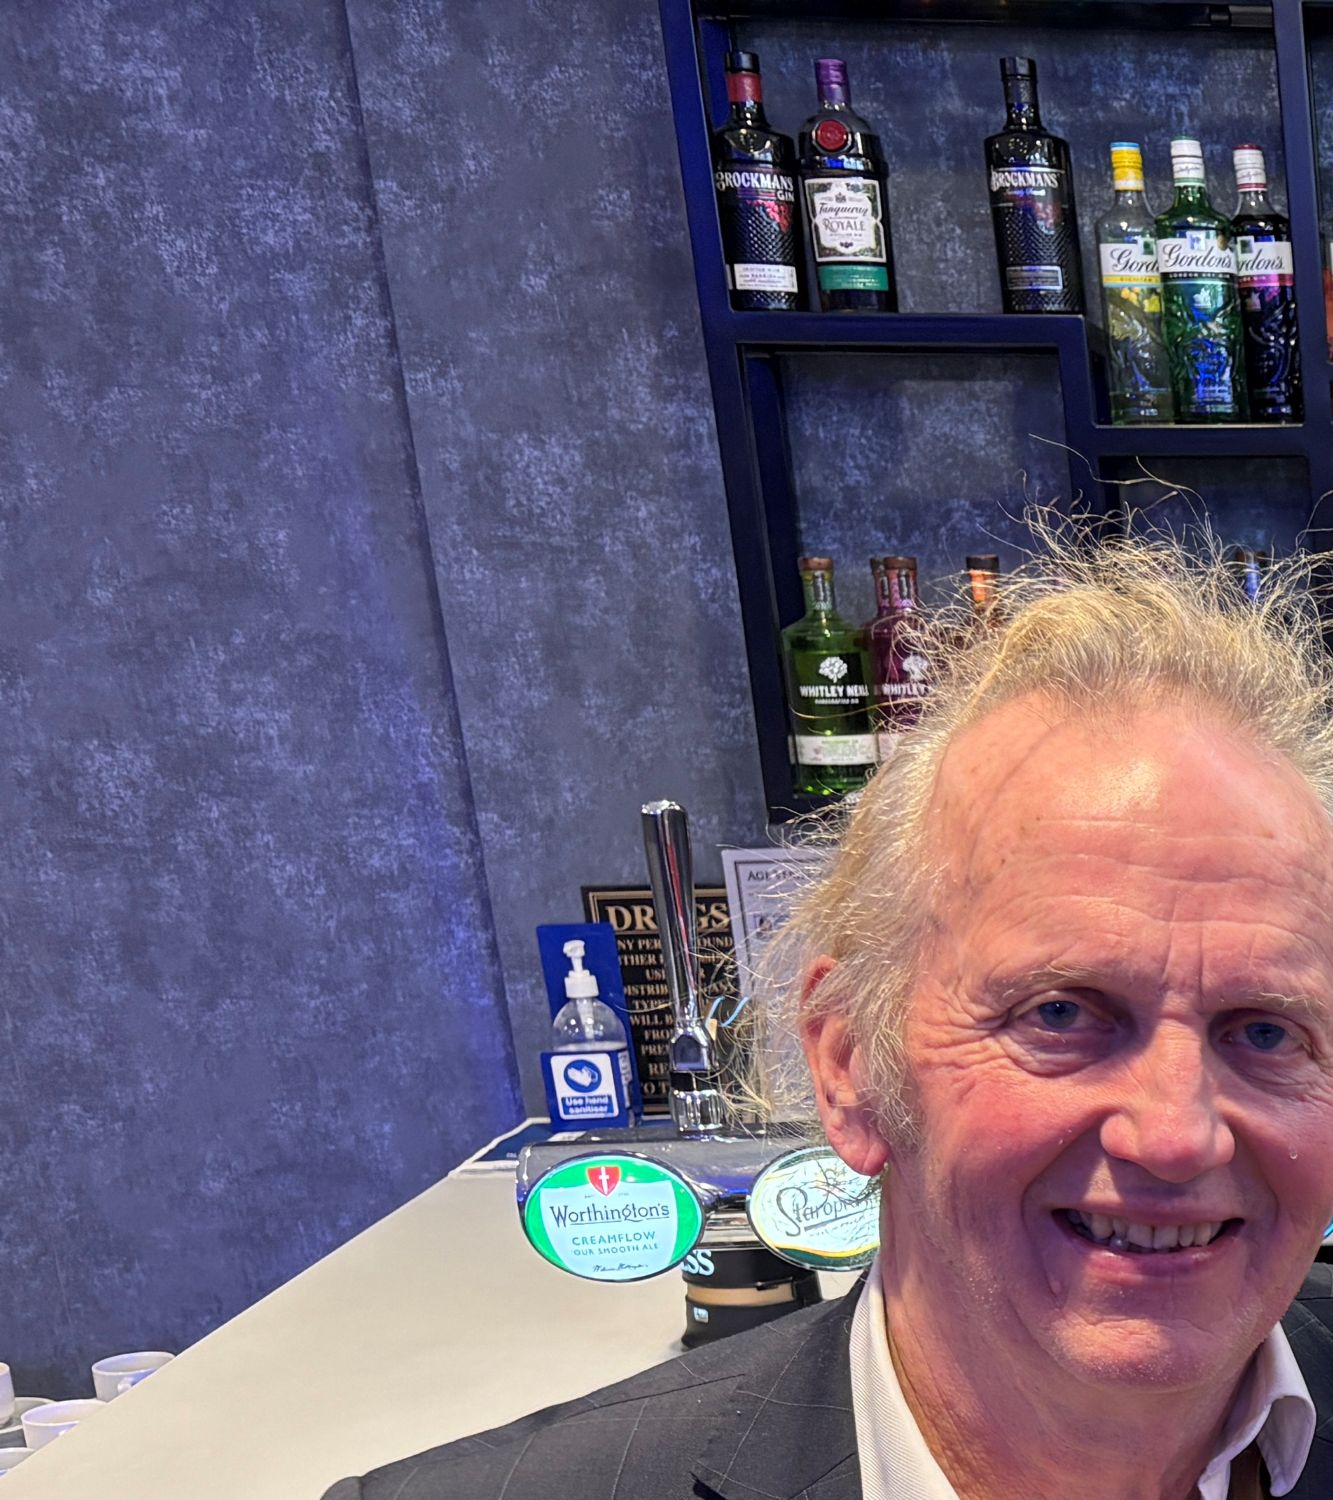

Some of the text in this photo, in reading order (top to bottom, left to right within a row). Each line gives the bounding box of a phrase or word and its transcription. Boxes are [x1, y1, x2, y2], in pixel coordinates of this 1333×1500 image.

[715, 171, 794, 191] BROCKMANS
[990, 169, 1059, 191] BROCKMANS
[777, 190, 795, 201] GIN
[823, 218, 866, 232] ROYALE
[1110, 248, 1159, 272] Gord
[1163, 243, 1232, 268] Gordon's
[1238, 248, 1284, 271] rdon's
[799, 684, 870, 698] WHITLEY NEILL
[605, 902, 730, 932] DRGS
[638, 937, 662, 950] PER
[698, 935, 733, 948] OUND
[629, 1014, 664, 1026] WILL
[644, 1029, 672, 1040] FRO
[565, 1096, 583, 1106] Use
[549, 1202, 670, 1228] Worthington's
[775, 1185, 878, 1238] Staropr
[571, 1231, 656, 1246] CREAMFLOW
[573, 1242, 658, 1256] OUR SMOOTH ALE
